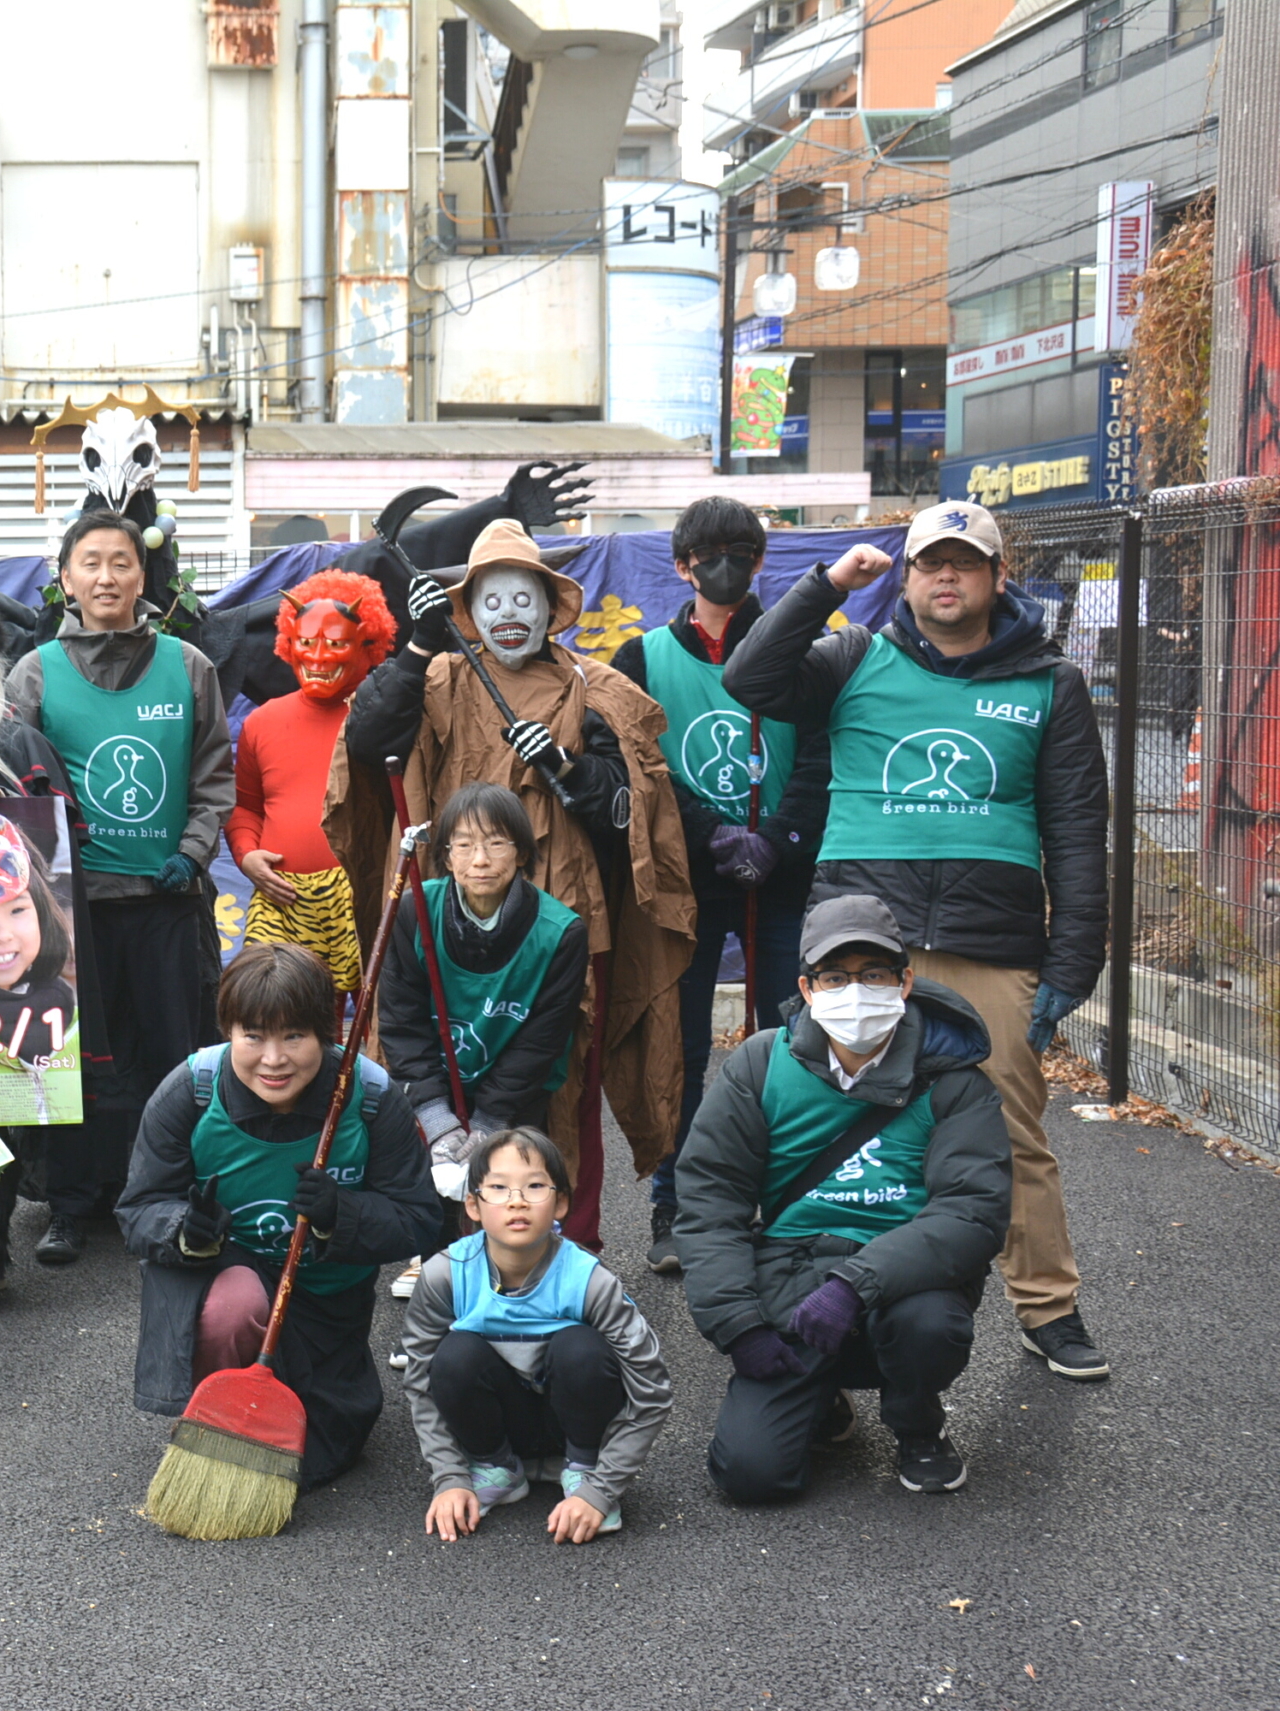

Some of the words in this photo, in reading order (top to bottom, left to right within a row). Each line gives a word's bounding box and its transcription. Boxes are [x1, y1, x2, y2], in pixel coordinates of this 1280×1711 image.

[1037, 333, 1065, 354] 下北沢店
[1106, 377, 1123, 499] PIGSTY
[137, 703, 183, 720] UACJ
[975, 699, 1041, 728] UACJ
[735, 805, 768, 817] bid
[882, 800, 941, 815] green
[947, 802, 990, 815] bird
[88, 822, 137, 837] green
[140, 827, 168, 838] bird
[482, 997, 530, 1022] UACJ
[33, 1054, 76, 1073] (Sat)
[864, 1183, 908, 1205] bird
